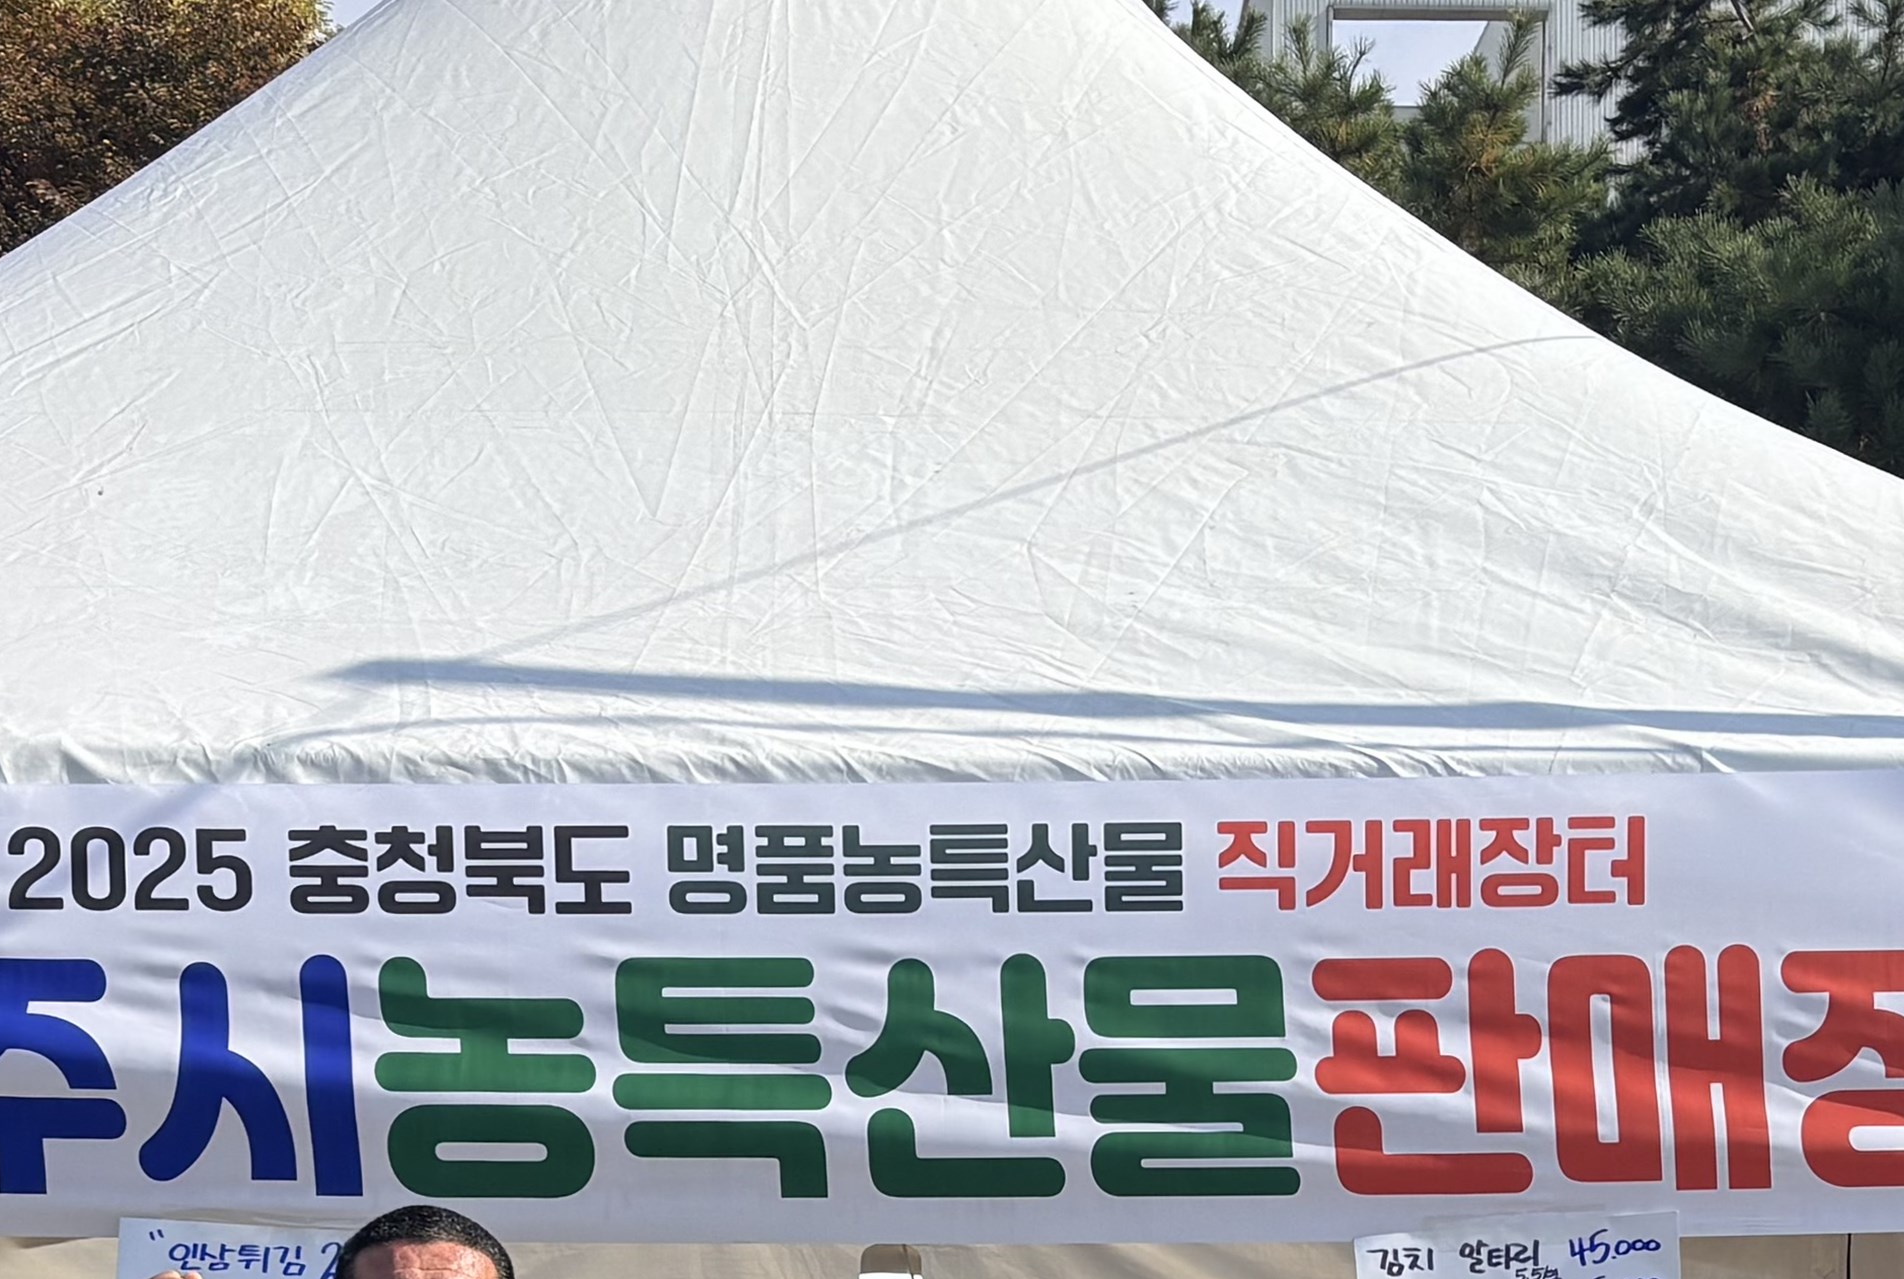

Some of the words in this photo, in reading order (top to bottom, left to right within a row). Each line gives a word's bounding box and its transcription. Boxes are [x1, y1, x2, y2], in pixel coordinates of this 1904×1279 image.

[7, 824, 254, 914] 2025
[286, 823, 632, 917] 충청북도
[669, 822, 1187, 918] 명품농특산물
[1217, 815, 1645, 912] 직거래장터
[1366, 1248, 1434, 1277] 김치
[1459, 1239, 1541, 1274] 알타리
